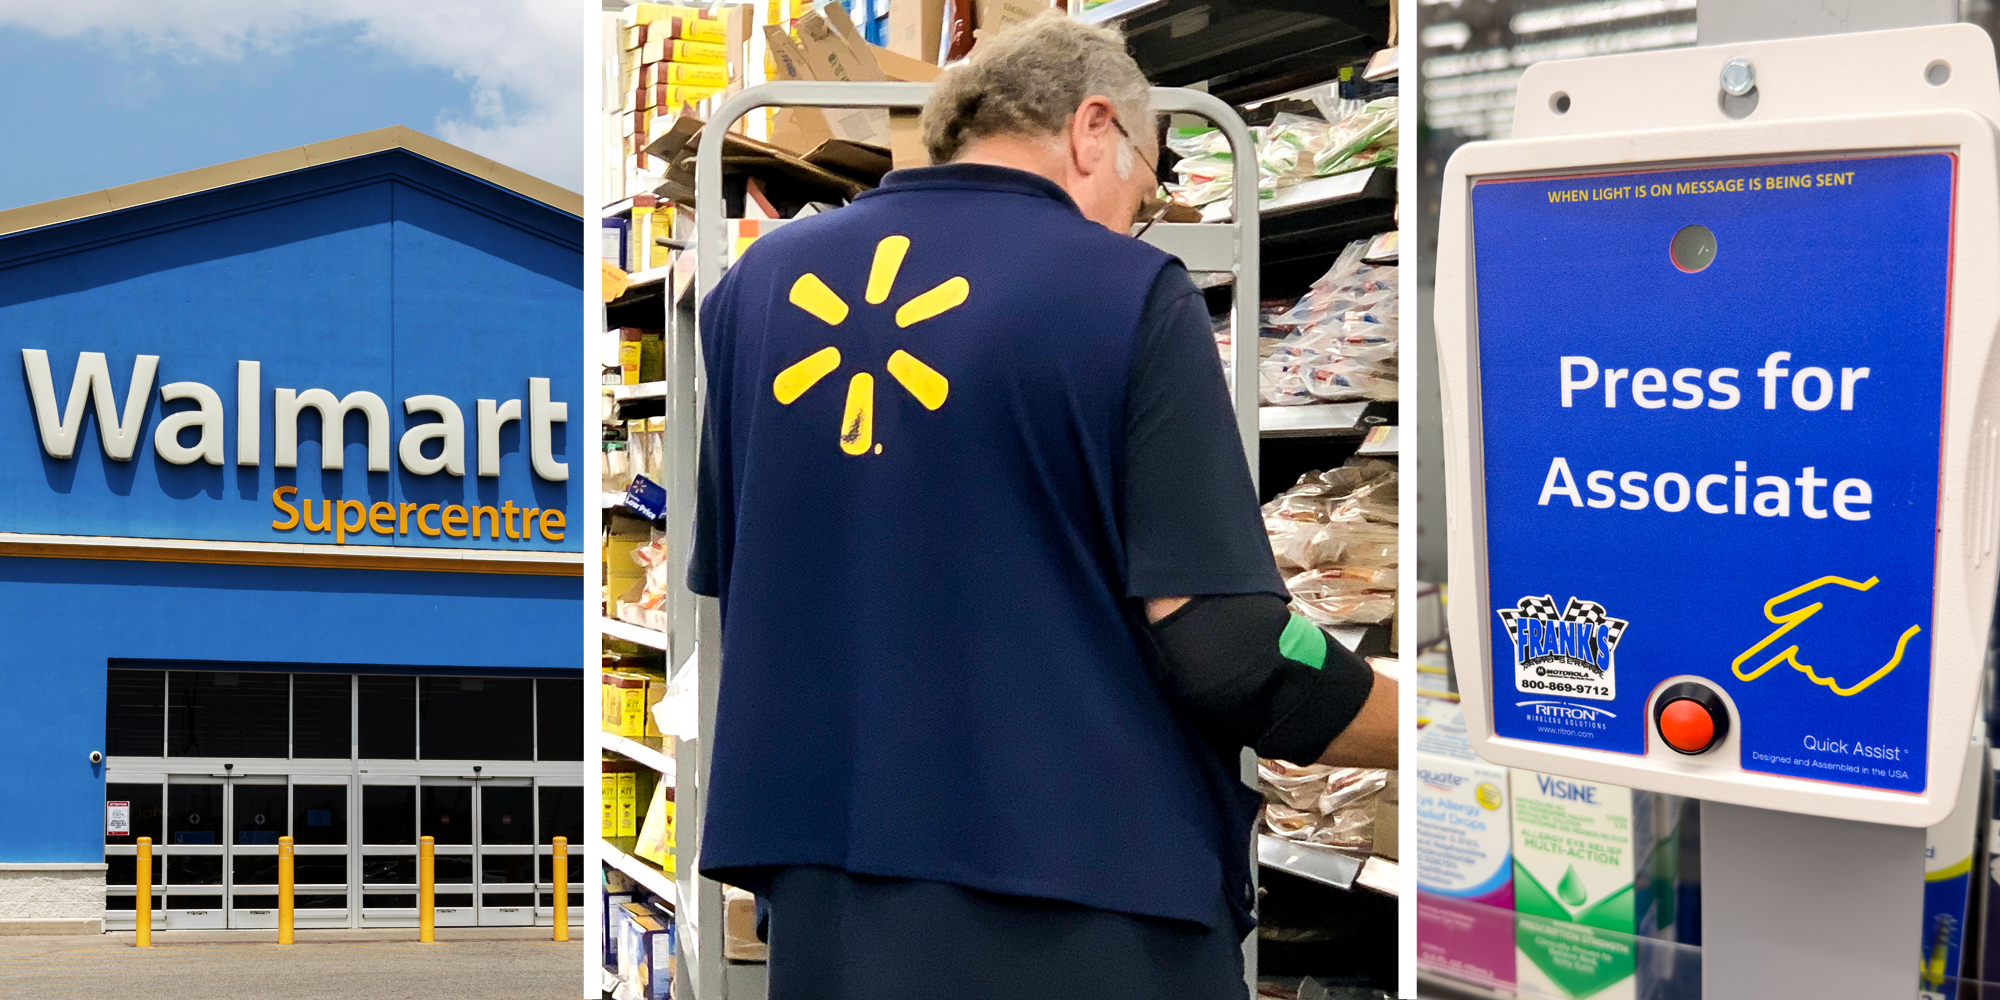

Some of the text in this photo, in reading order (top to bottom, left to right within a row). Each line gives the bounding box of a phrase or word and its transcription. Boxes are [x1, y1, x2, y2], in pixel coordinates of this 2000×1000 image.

[1548, 172, 1855, 203] WHEN LIGHT IS ON MESSAGE IS BEING SENT
[1560, 350, 1871, 412] Press for
[21, 348, 570, 482] Walmart
[1537, 456, 1873, 521] Associate
[271, 486, 567, 544] Supercentre
[1546, 669, 1589, 678] MOTOROLA
[1521, 680, 1609, 696] 800-869-9712
[626, 701, 639, 709] KIT
[1526, 714, 1606, 730] WIRELESS SOLUTIONS
[1538, 726, 1594, 739] www.ritron.com
[1803, 735, 1900, 761] Quick Assist
[1752, 751, 1909, 779] Designed and Assembled in the USA
[1537, 774, 1597, 805] VISINE
[1521, 828, 1623, 856] ALLERGY EYE RELIEF
[1524, 837, 1625, 866] MULTI-ACTION
